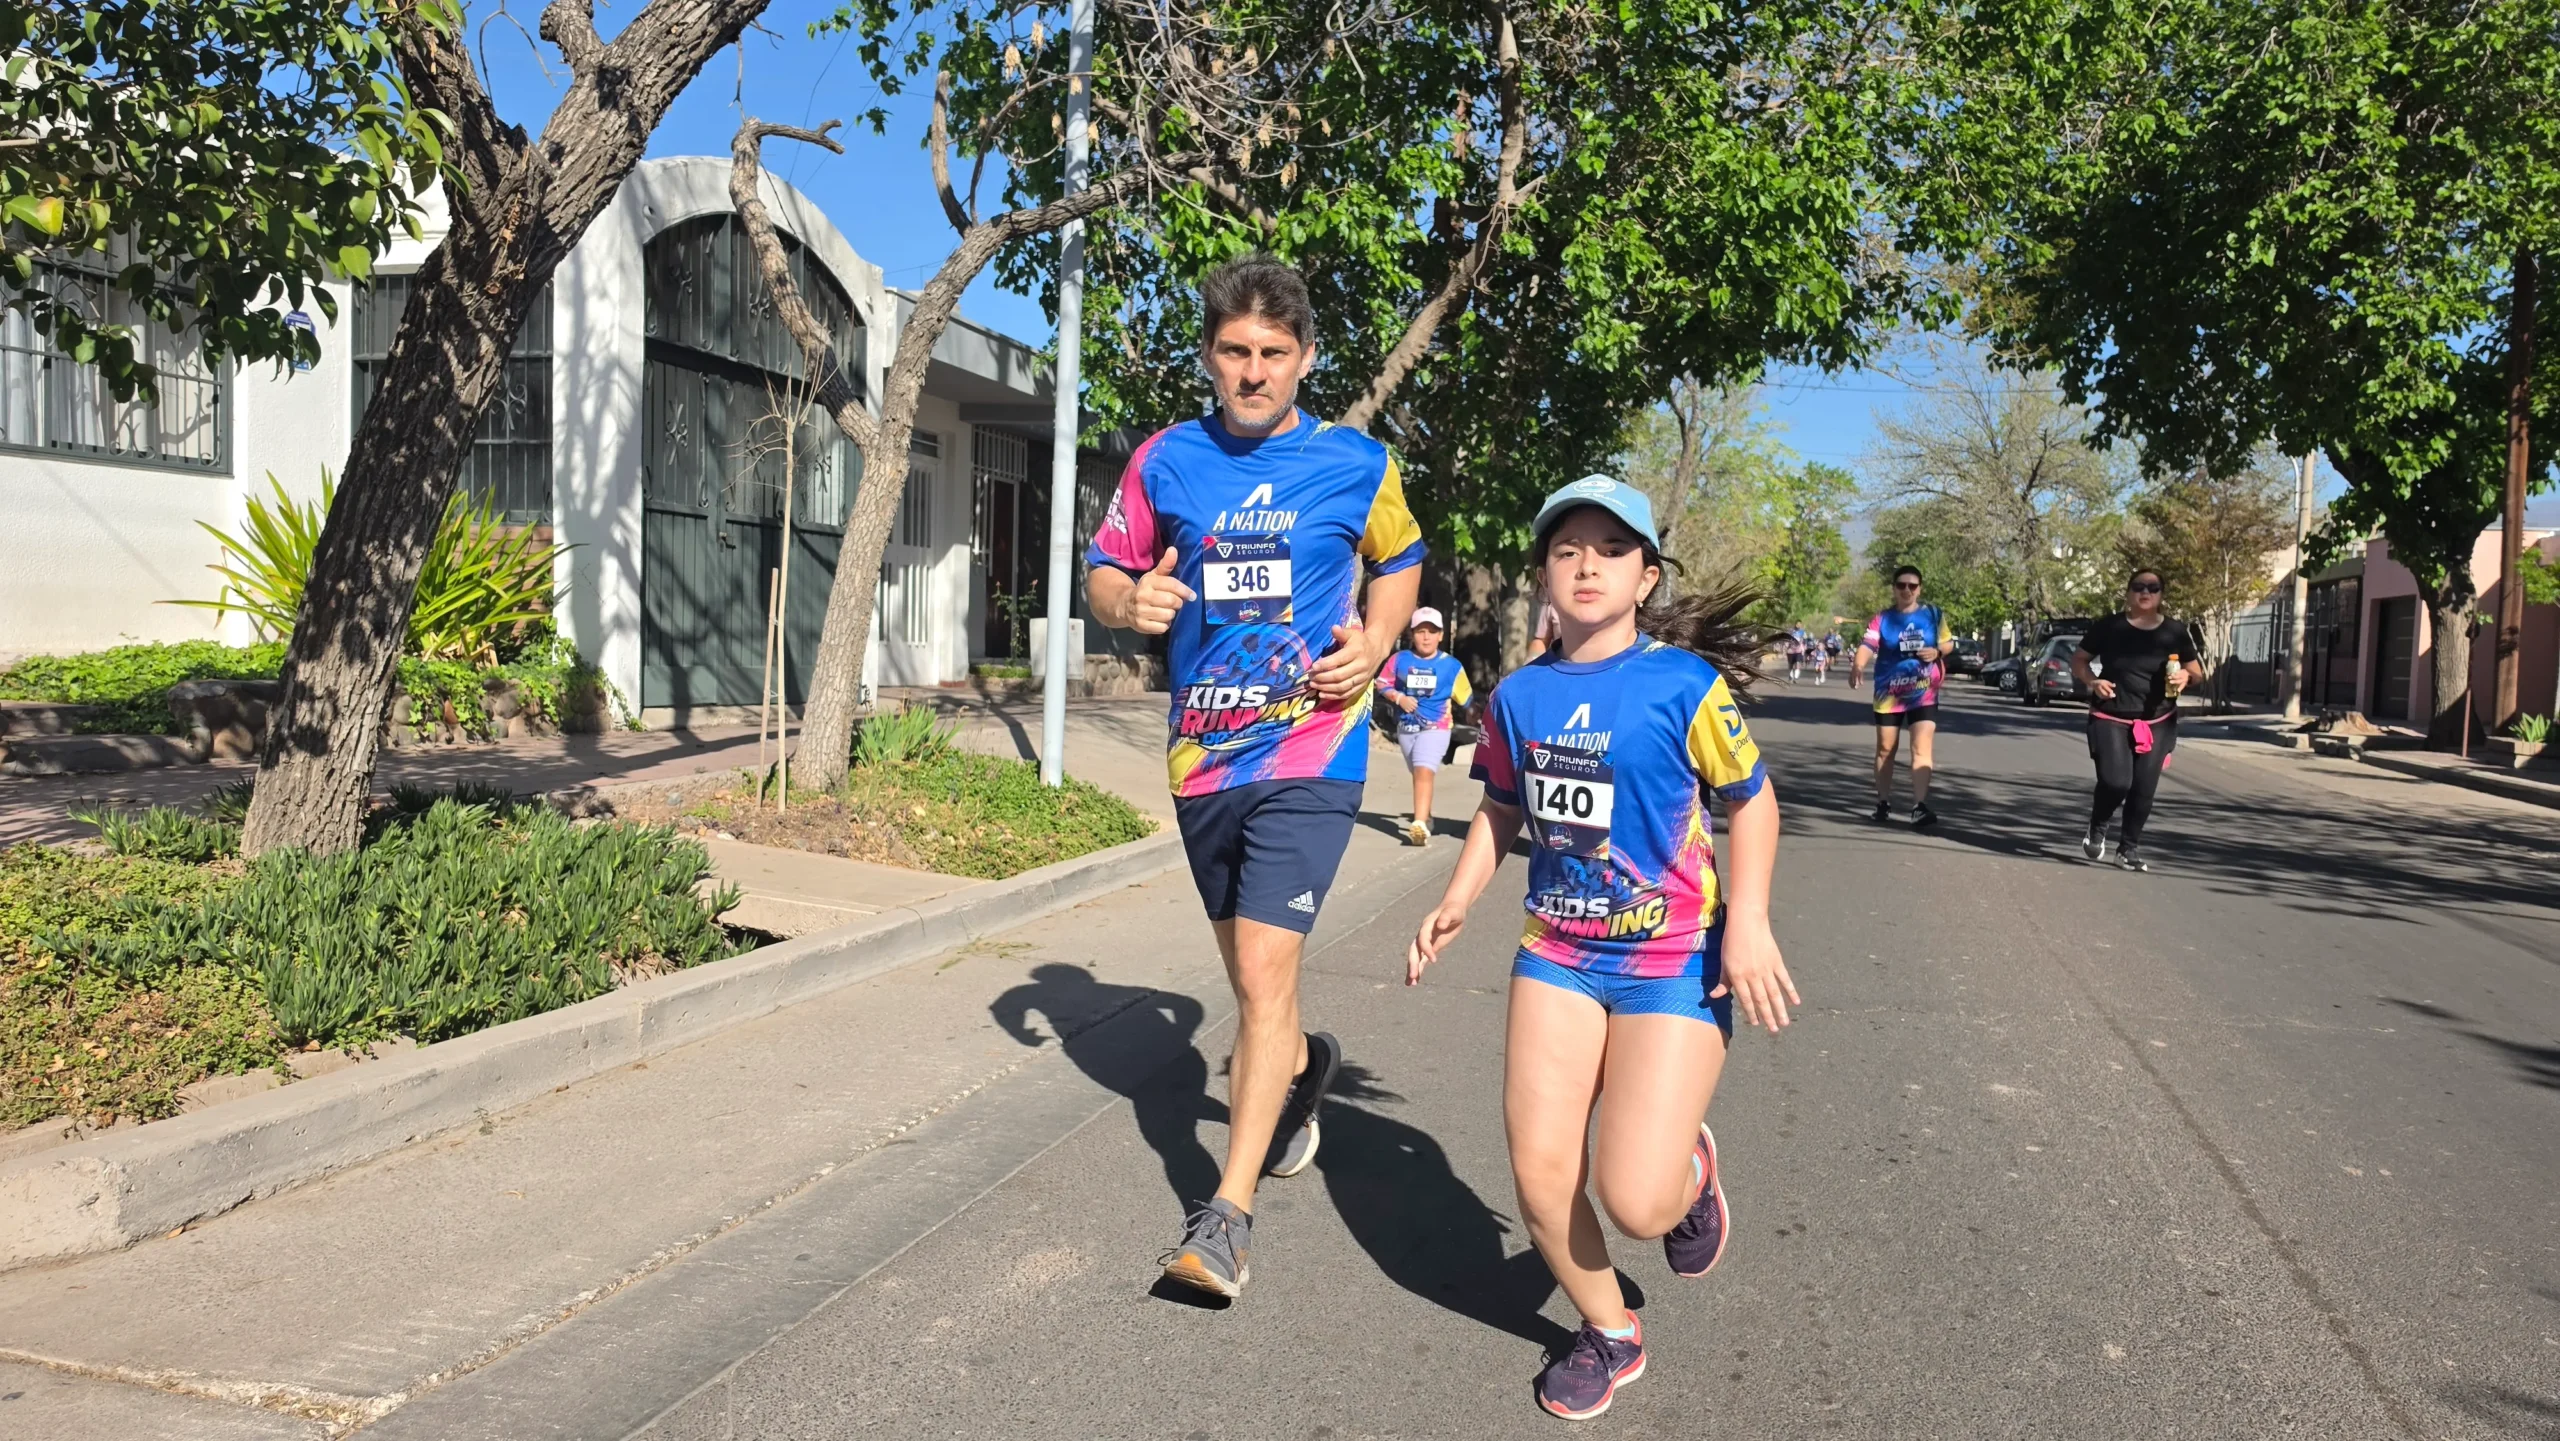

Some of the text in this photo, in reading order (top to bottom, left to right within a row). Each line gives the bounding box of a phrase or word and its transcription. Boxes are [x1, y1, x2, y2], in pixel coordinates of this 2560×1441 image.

[1213, 510, 1298, 532] A NATION
[1227, 565, 1270, 592] 346
[1415, 677, 1429, 686] 278
[1186, 684, 1270, 710] KIDS
[1180, 695, 1317, 738] RUNNING
[1556, 731, 1612, 752] NATION
[1553, 754, 1599, 768] TRIUNFO
[1553, 763, 1597, 774] SEGUROS
[1535, 779, 1594, 819] 140
[1288, 901, 1315, 913] adidas
[1537, 895, 1610, 918] KIDS
